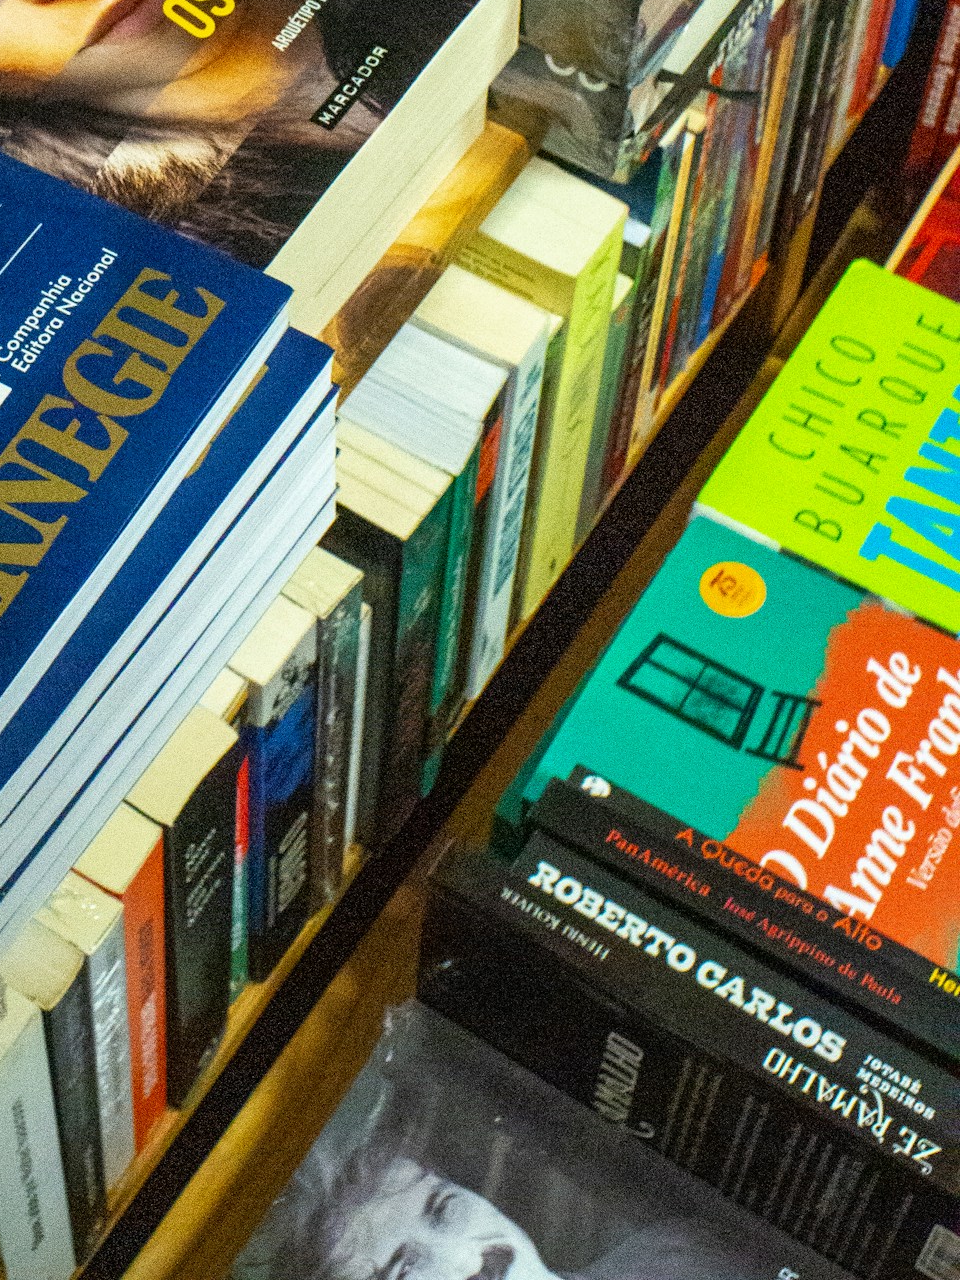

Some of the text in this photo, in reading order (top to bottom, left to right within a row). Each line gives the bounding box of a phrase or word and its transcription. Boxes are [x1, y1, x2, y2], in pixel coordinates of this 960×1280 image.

[271, 0, 321, 53] ARQUÉTIPO
[317, 45, 389, 125] MARCADOR
[11, 247, 118, 373] Editora Nacional
[768, 334, 876, 462] CHICO
[793, 313, 960, 543] BUARQUE
[782, 707, 891, 860] Diário
[866, 651, 922, 709] de
[604, 828, 902, 1005] PanAmérica José Agrippino de Paula
[675, 827, 695, 856] A
[774, 887, 814, 916] para
[816, 909, 829, 922] o
[832, 915, 882, 951] Alto
[823, 805, 916, 920] Anne
[905, 827, 952, 891] Versão
[527, 860, 847, 1066] ROBERTO CARLOS
[761, 1046, 942, 1175] ZÉ RAMALHO
[856, 1066, 935, 1121] MEDEIROS
[862, 1053, 923, 1095] JOTABÊ
